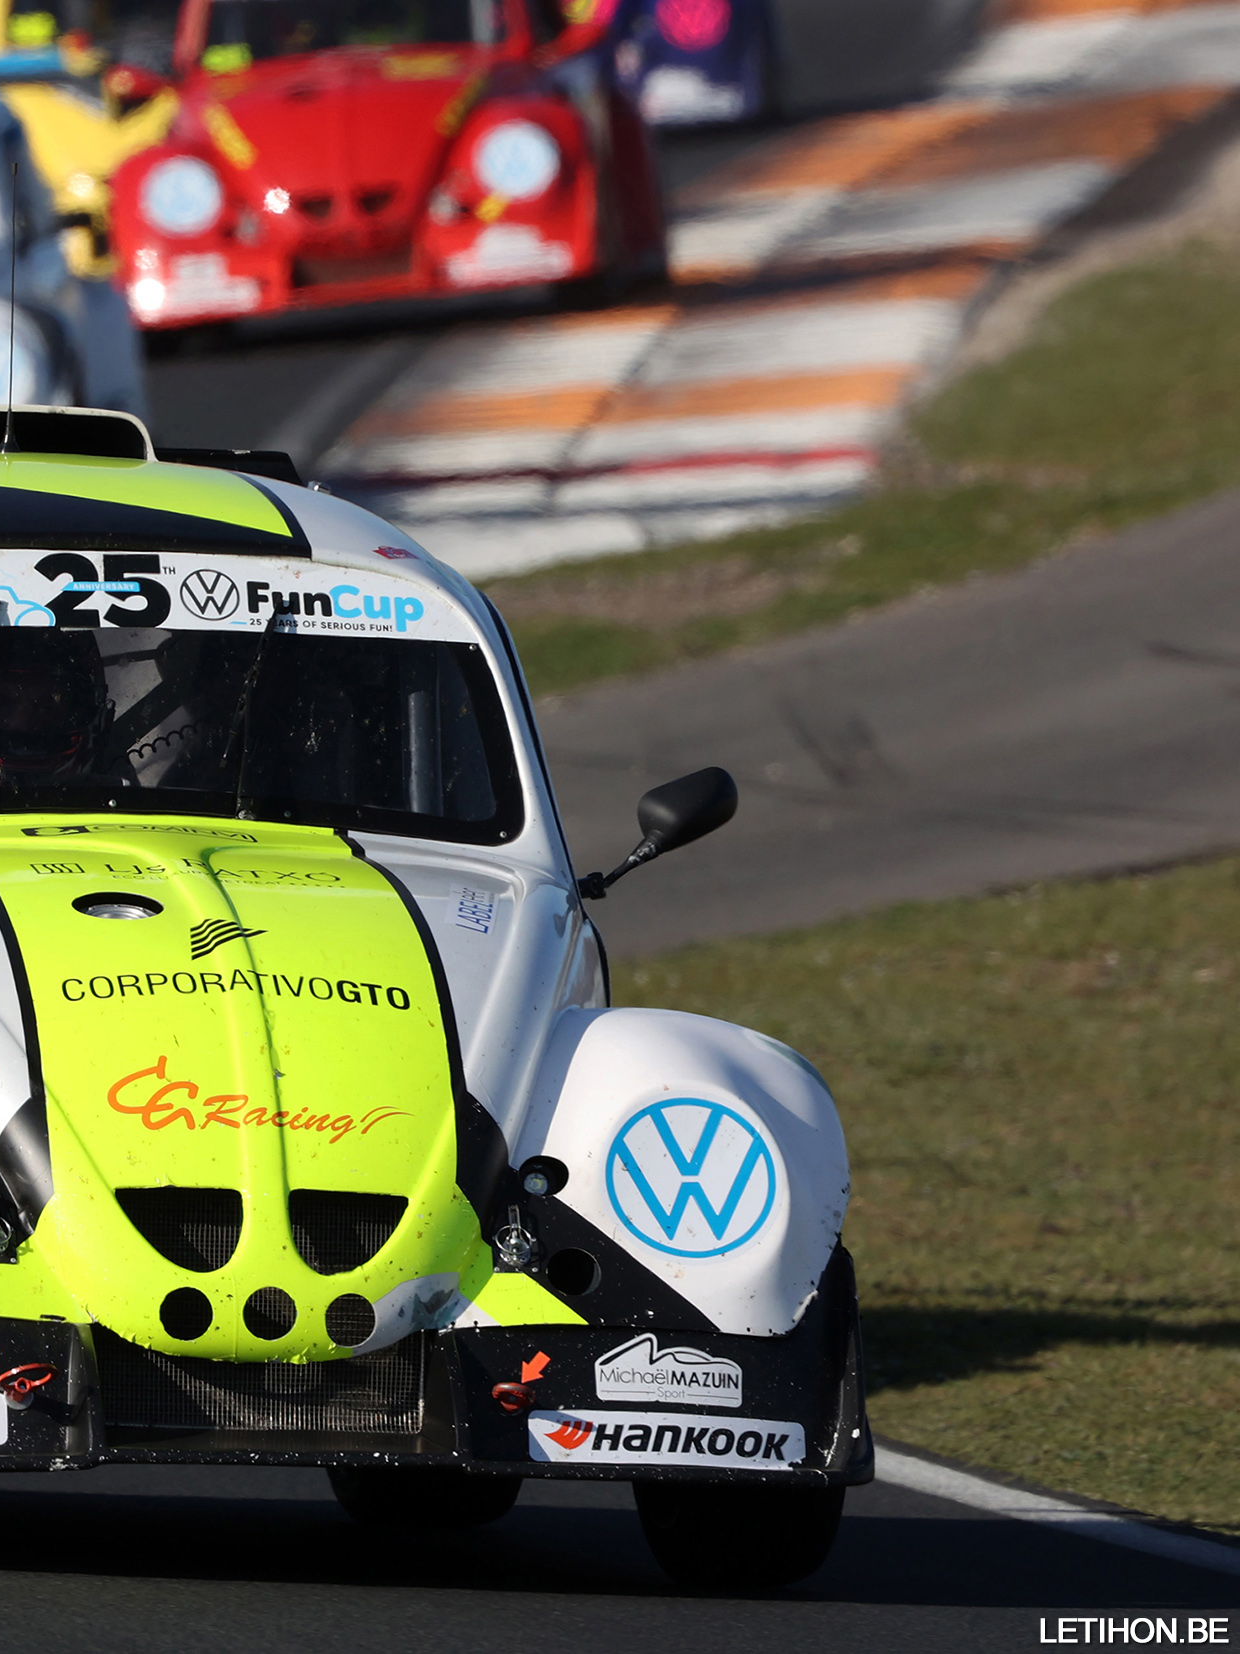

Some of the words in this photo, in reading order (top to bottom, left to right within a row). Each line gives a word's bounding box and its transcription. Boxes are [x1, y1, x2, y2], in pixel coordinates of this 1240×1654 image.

[72, 582, 135, 591] ANNIVERSARY
[246, 580, 424, 632] FunCup
[249, 618, 262, 626] 25
[302, 620, 318, 629] OF
[321, 621, 366, 632] SERIOUS
[369, 624, 393, 632] FUN!
[656, 1388, 686, 1400] Sport
